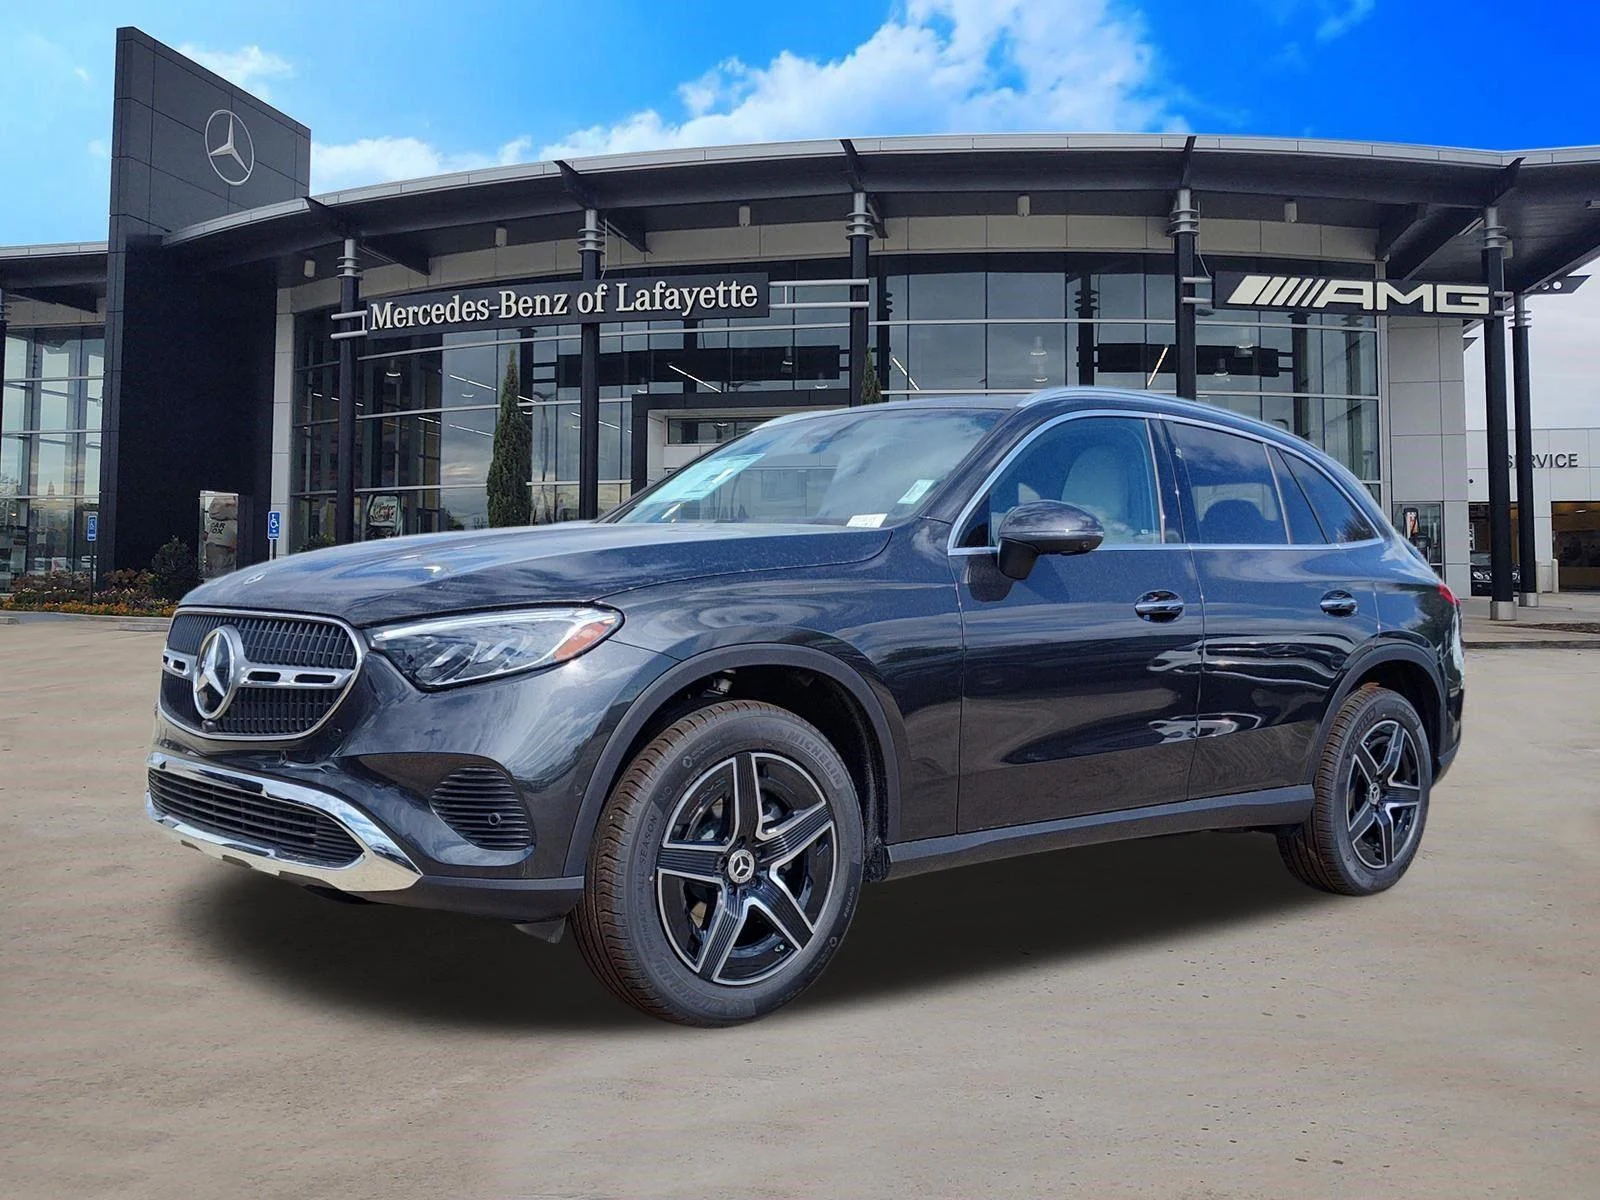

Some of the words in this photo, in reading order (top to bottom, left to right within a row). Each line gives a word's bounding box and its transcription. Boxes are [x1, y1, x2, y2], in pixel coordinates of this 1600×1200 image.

[370, 289, 567, 330] Mercedes-Benz
[577, 285, 606, 314] of
[615, 280, 758, 316] Lafayette
[1313, 279, 1490, 314] AMG
[1508, 453, 1578, 468] SRVICE
[786, 730, 844, 786] MICHELIN
[639, 813, 659, 866] SEASON
